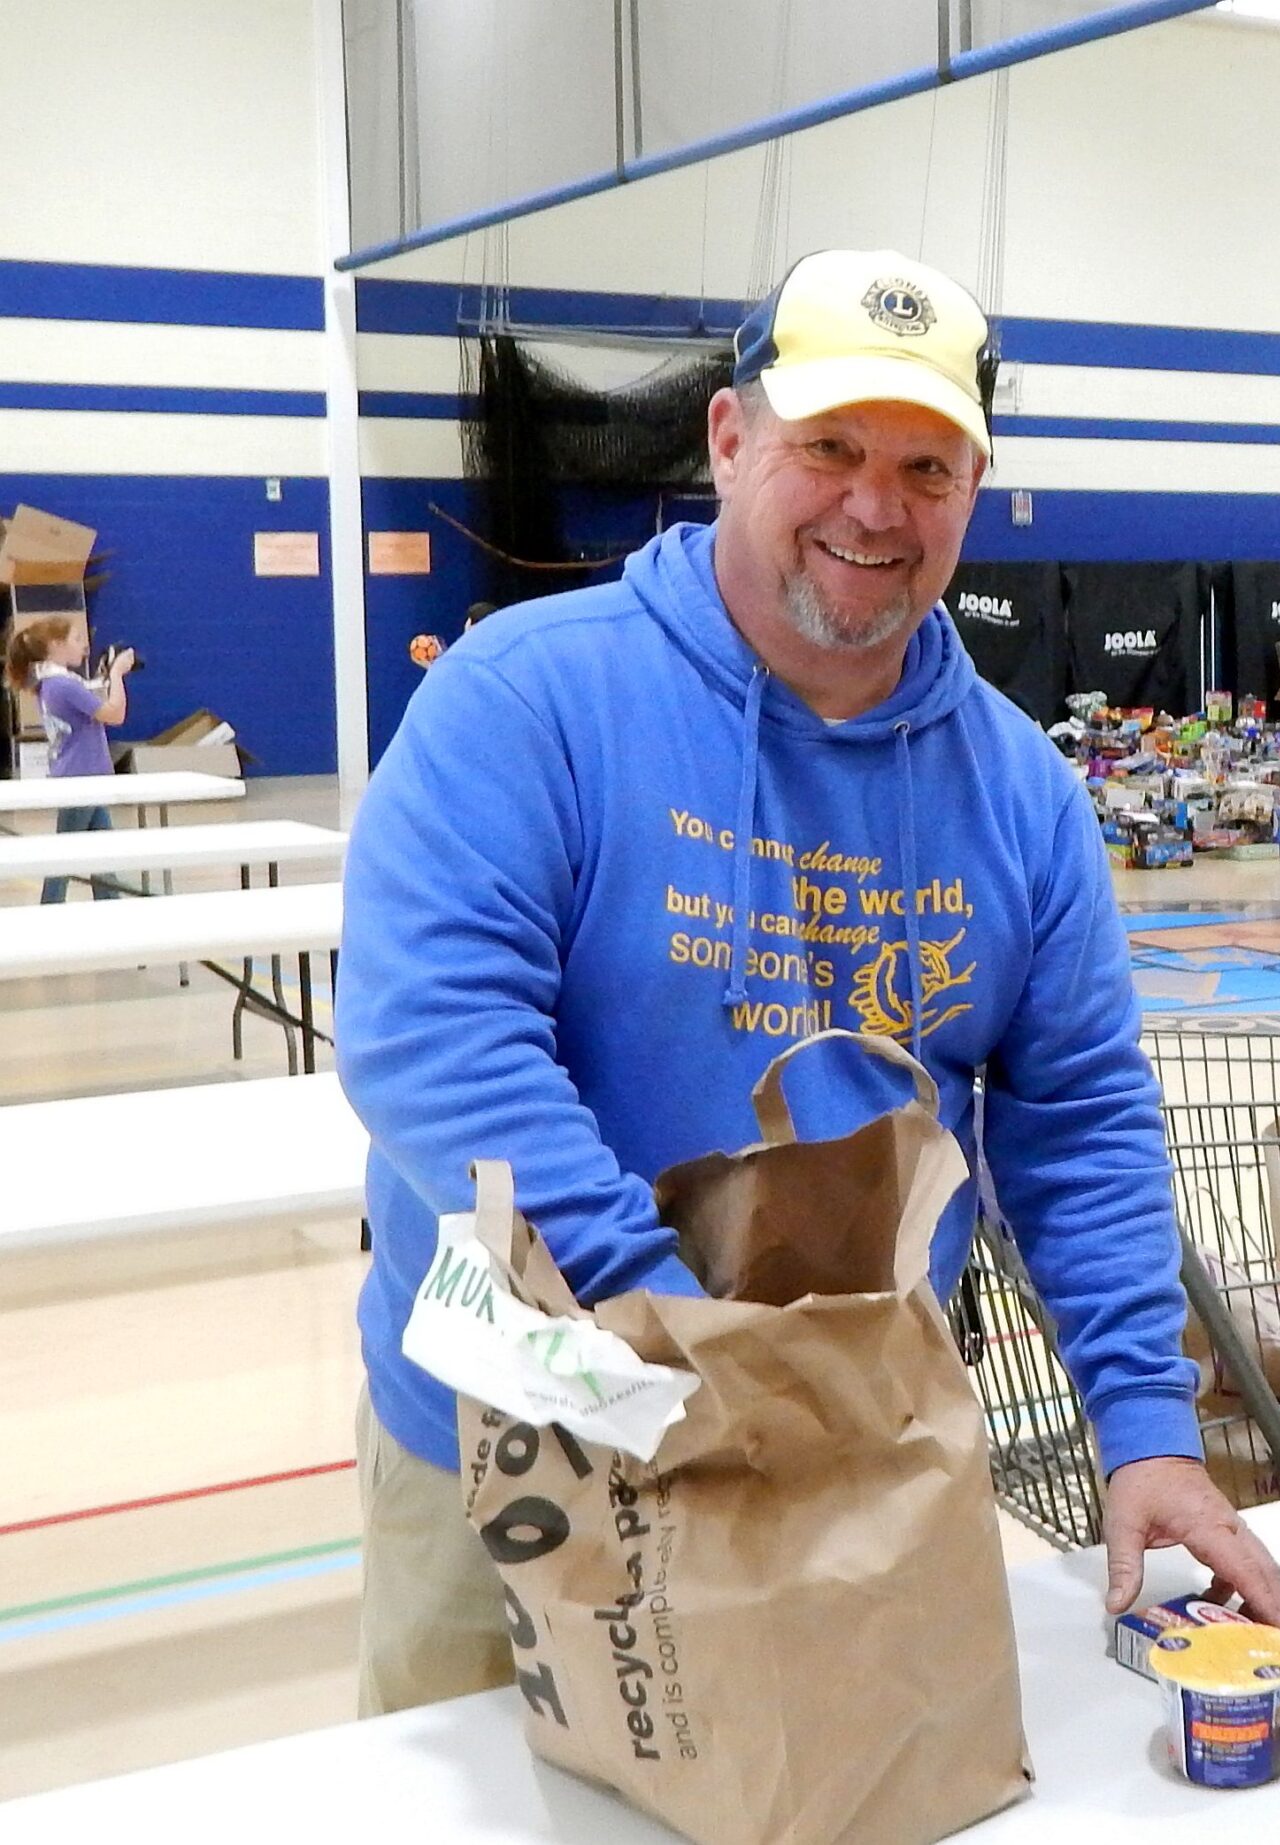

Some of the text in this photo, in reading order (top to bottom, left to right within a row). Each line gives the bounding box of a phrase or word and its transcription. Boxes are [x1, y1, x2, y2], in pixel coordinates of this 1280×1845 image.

[958, 591, 1012, 618] JOOLA
[1104, 630, 1157, 650] JOOLA
[666, 884, 709, 918] but
[790, 875, 847, 915] the
[662, 1681, 683, 1706] is
[665, 1711, 698, 1761] and
